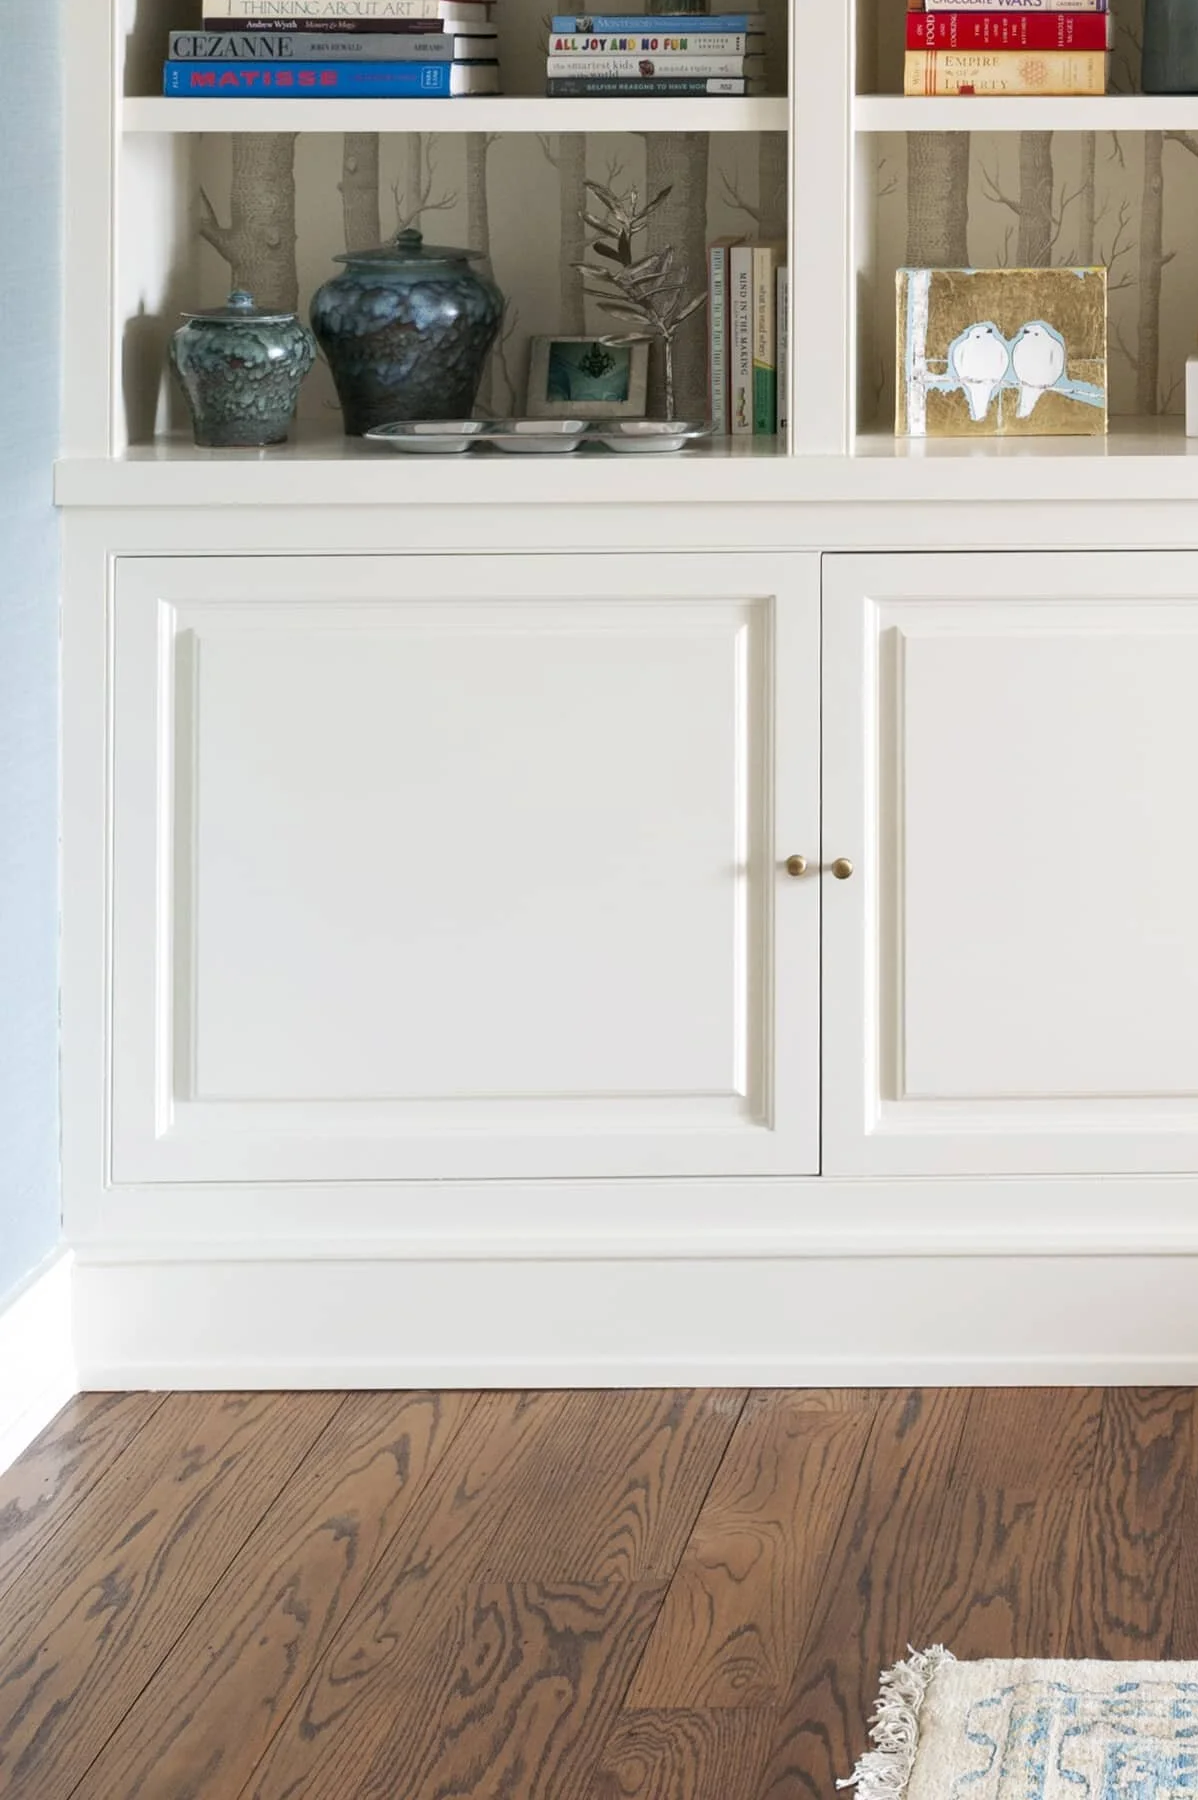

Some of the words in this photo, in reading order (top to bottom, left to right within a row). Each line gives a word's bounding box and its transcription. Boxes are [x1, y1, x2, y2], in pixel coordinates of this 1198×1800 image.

[242, 1, 320, 16] THINKING
[322, 1, 386, 16] ABOUT
[387, 2, 414, 16] ART
[246, 20, 272, 29] Andrew
[274, 20, 298, 30] Wyeth
[926, 14, 934, 46] FOOD
[173, 36, 294, 57] CEZANNE
[554, 38, 577, 50] ALL
[582, 38, 608, 50] JOY
[610, 38, 636, 50] AND
[641, 38, 658, 50] NO
[664, 38, 688, 50] FUN
[568, 60, 610, 70] smartest
[612, 59, 634, 70] kids
[946, 56, 999, 66] EMPIRE
[190, 71, 338, 86] MATISSE
[740, 300, 748, 311] IN
[760, 305, 767, 314] to
[740, 314, 748, 332] THE
[759, 315, 767, 333] read
[740, 337, 748, 376] MAKING
